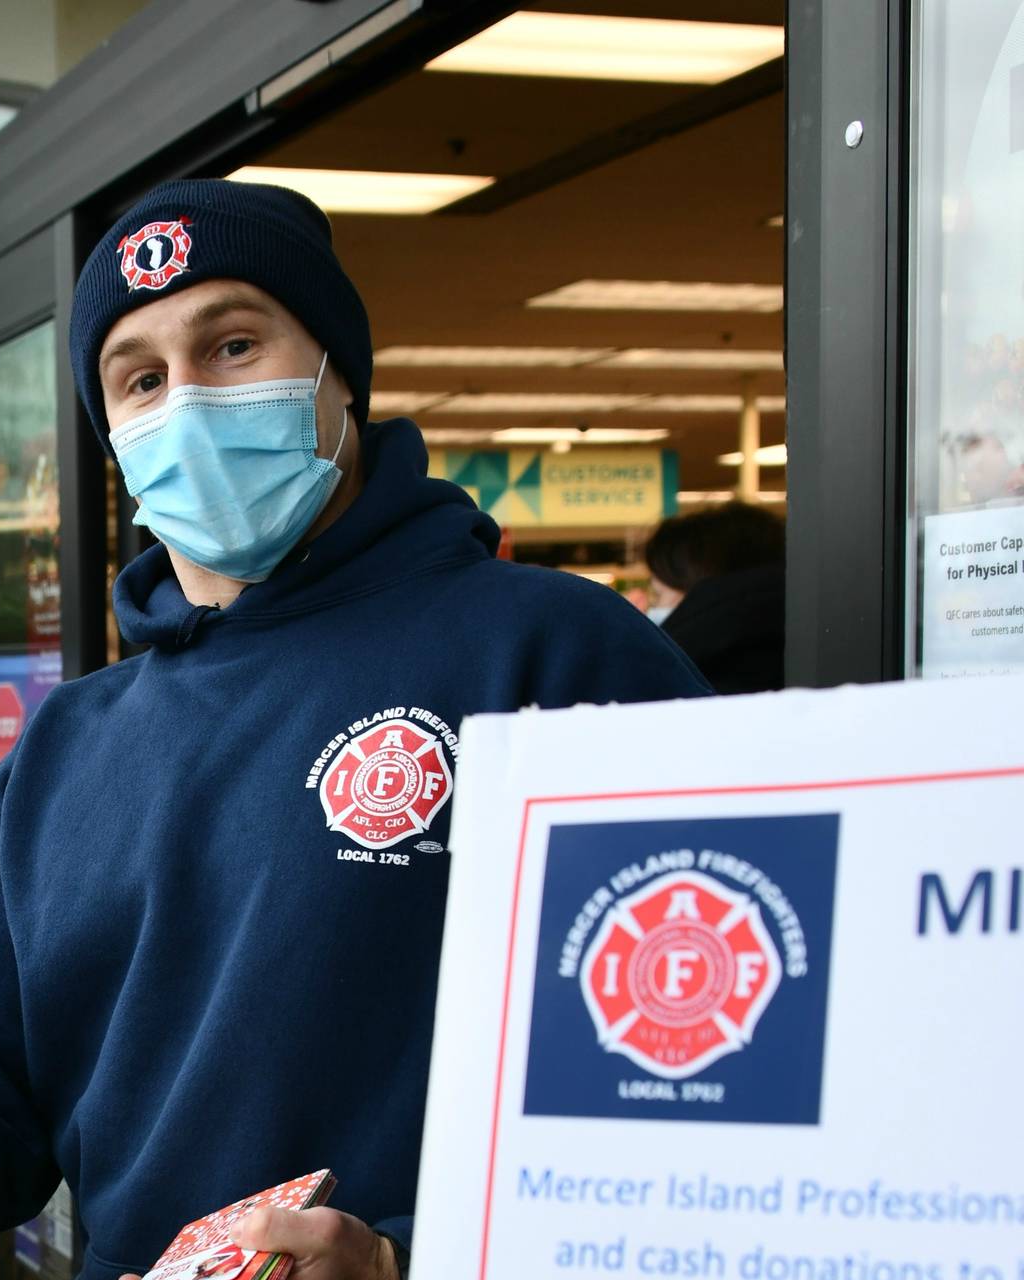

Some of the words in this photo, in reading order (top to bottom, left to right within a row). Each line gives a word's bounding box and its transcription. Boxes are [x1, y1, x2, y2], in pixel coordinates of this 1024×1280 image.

[547, 464, 656, 482] CUSTOMER
[561, 490, 646, 507] SERVICE
[940, 541, 997, 556] Customer
[947, 567, 964, 580] for
[967, 560, 1018, 580] Physical
[946, 609, 961, 620] QFC
[962, 610, 981, 619] cares
[982, 607, 1004, 617] about
[971, 626, 1009, 637] customers
[1010, 624, 1024, 634] and
[305, 733, 348, 789] MERCER
[347, 706, 406, 735] ISLAND
[379, 730, 404, 748] A
[334, 770, 348, 796] I
[373, 766, 399, 796] F
[422, 772, 443, 800] F
[352, 815, 372, 827] AFL
[384, 817, 406, 827] CIO
[365, 830, 388, 840] CLC
[337, 849, 375, 863] LOCAL
[379, 853, 410, 865] 1762
[558, 887, 614, 978] MERCER
[610, 848, 695, 894] ISLAND
[697, 848, 808, 978] FIREFIGHTERS
[664, 889, 701, 922] A
[602, 952, 621, 997] I
[663, 951, 701, 998] F
[733, 952, 765, 998] F
[618, 1080, 677, 1101] LOCAL
[681, 1081, 725, 1103] 1762
[516, 1166, 654, 1207] Mercer
[666, 1174, 784, 1214] Island
[555, 1236, 626, 1271] and
[638, 1242, 726, 1280] cash
